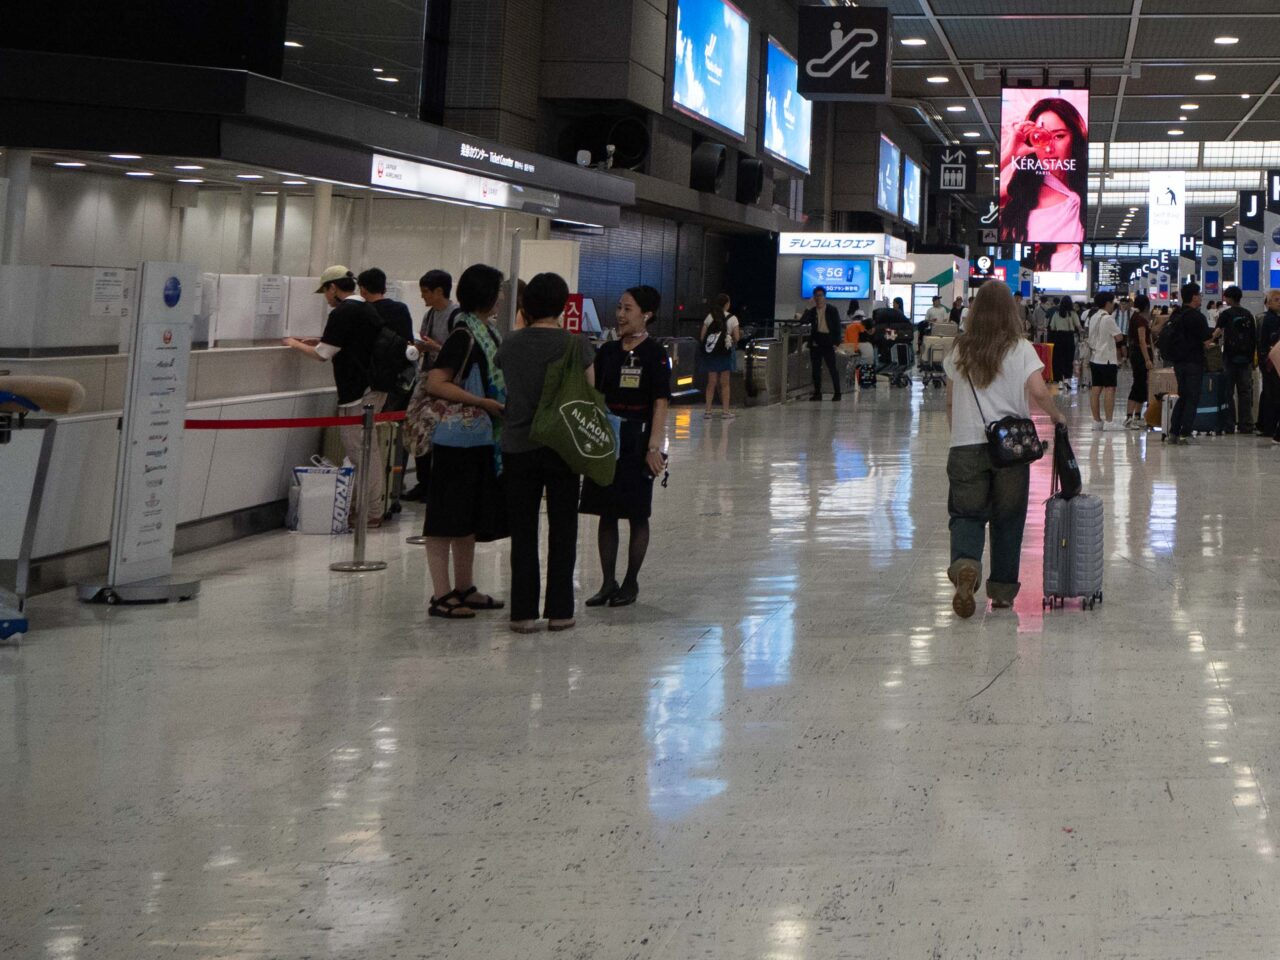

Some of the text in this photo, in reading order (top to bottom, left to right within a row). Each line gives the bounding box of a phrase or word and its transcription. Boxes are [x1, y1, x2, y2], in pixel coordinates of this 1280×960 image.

[1011, 155, 1077, 171] KÉRASTASE
[1246, 195, 1258, 217] J
[1211, 220, 1216, 237] I
[789, 238, 877, 248] テレコムスクエア
[1182, 236, 1194, 251] H
[1023, 245, 1032, 258] F
[1161, 252, 1169, 263] E
[1142, 263, 1150, 273] C
[1150, 258, 1159, 269] D
[826, 267, 843, 278] 5G
[1136, 268, 1142, 277] B
[567, 301, 580, 331] 入口
[571, 408, 587, 427] ALA
